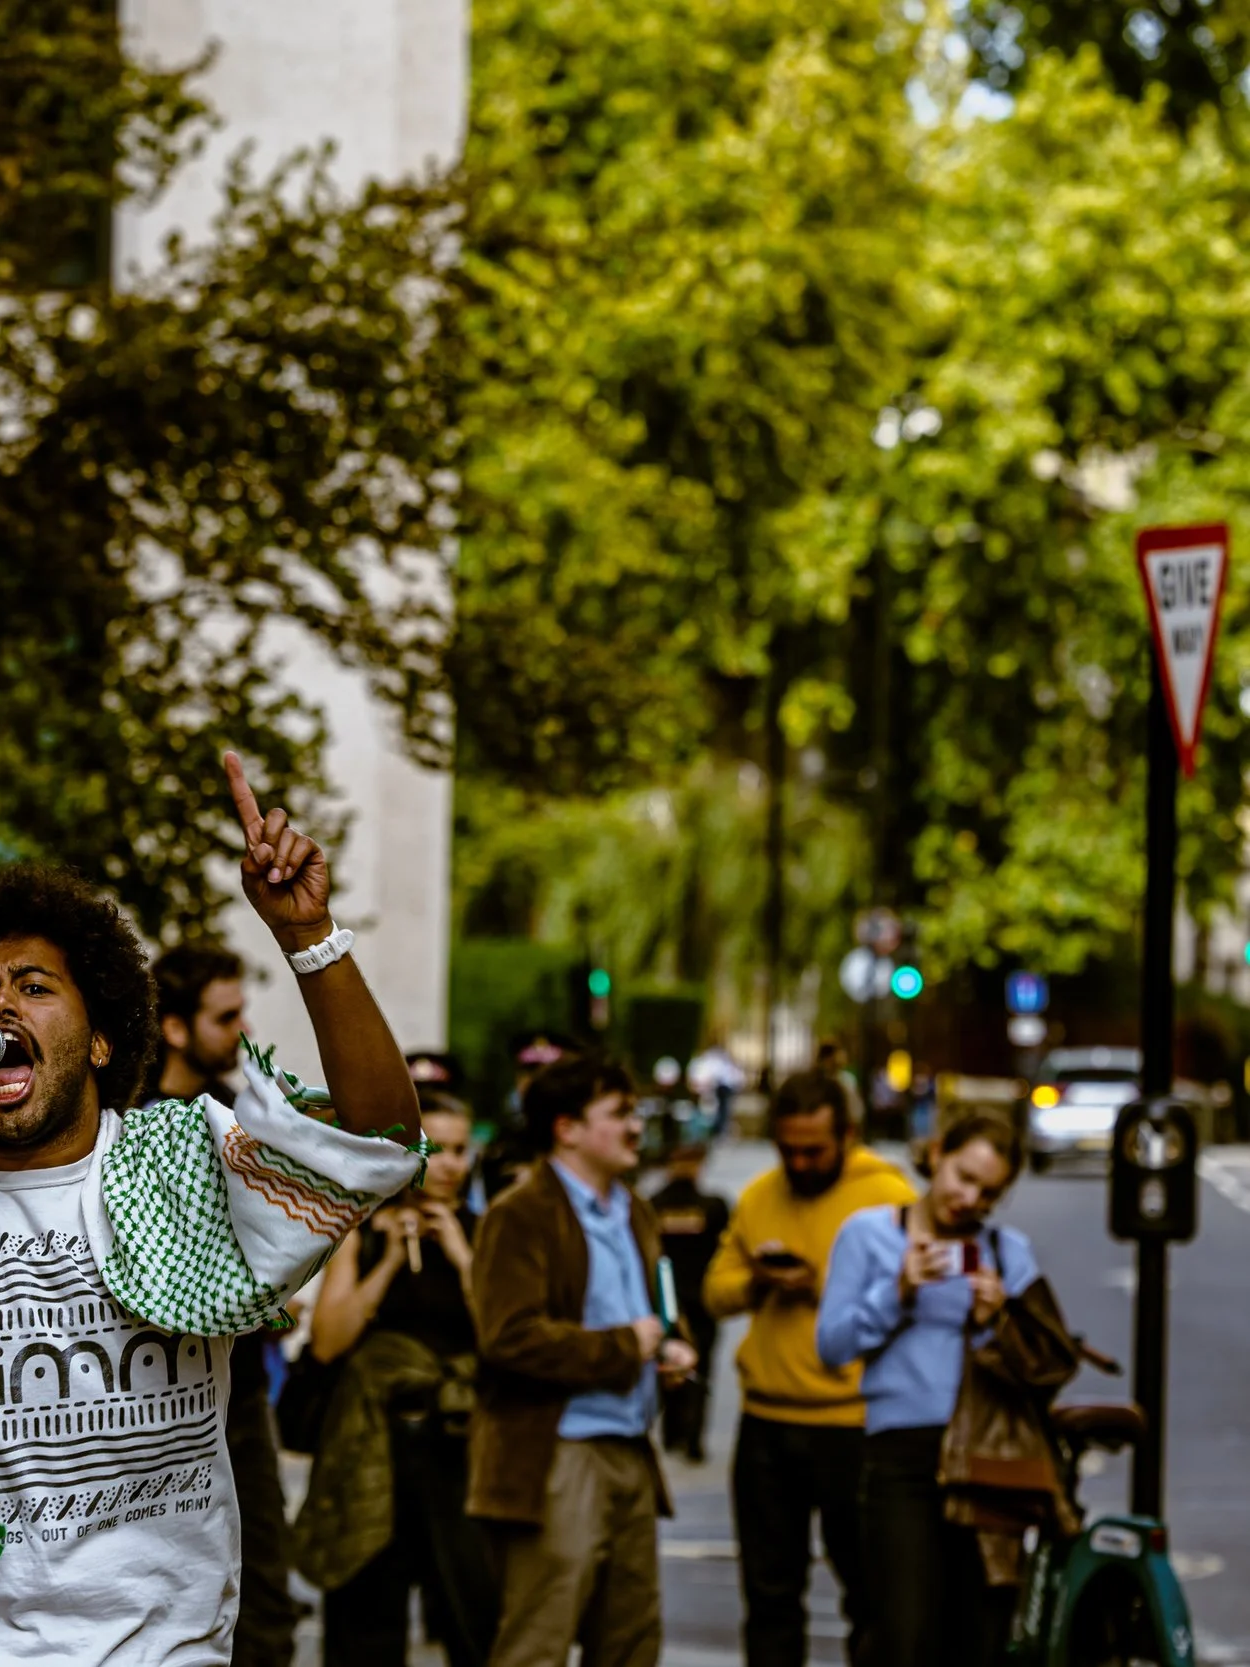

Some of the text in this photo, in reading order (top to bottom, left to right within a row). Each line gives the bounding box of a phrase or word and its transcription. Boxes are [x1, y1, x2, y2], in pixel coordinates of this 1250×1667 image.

[1159, 559, 1212, 611] GIVE
[42, 1528, 68, 1542] OUT
[77, 1524, 92, 1538] OF
[97, 1515, 120, 1531] ONE
[124, 1503, 166, 1522] COMES
[175, 1495, 212, 1513] MANY
